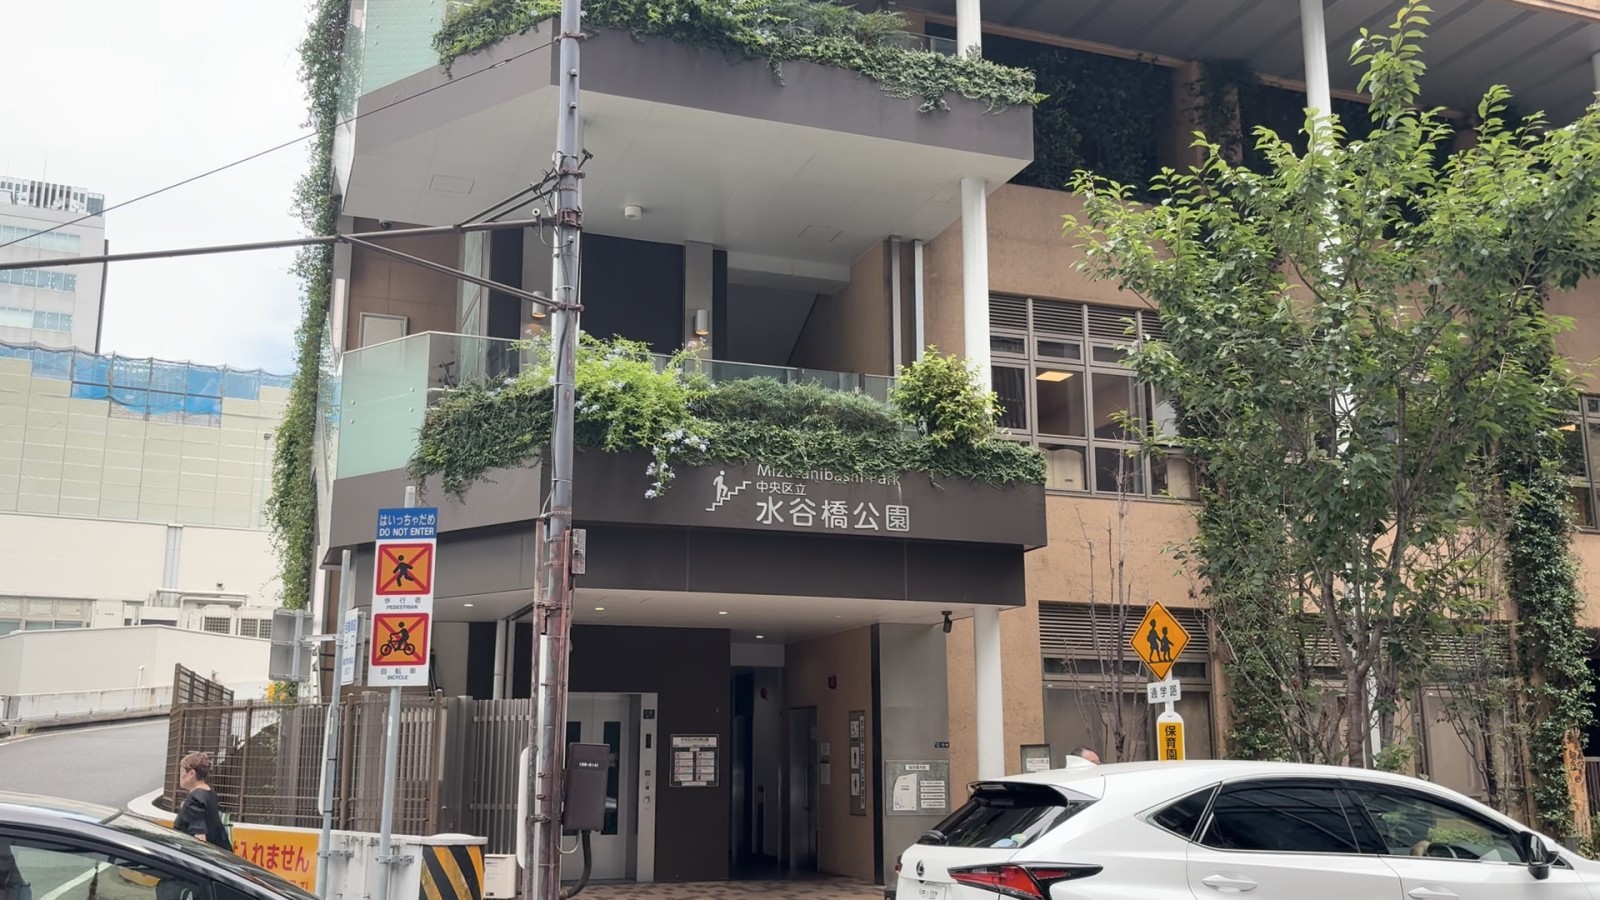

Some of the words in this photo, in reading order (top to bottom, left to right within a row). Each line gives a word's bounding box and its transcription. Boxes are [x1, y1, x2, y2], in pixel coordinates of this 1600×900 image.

[756, 480, 807, 495] 中央区立
[379, 514, 436, 527] はいっちゃだめ
[755, 496, 910, 532] 水谷橋公園
[379, 528, 391, 537] DO
[392, 528, 408, 537] NOT
[410, 527, 434, 536] ENTER
[1150, 685, 1177, 698] 通学路
[1165, 725, 1177, 760] 保育園
